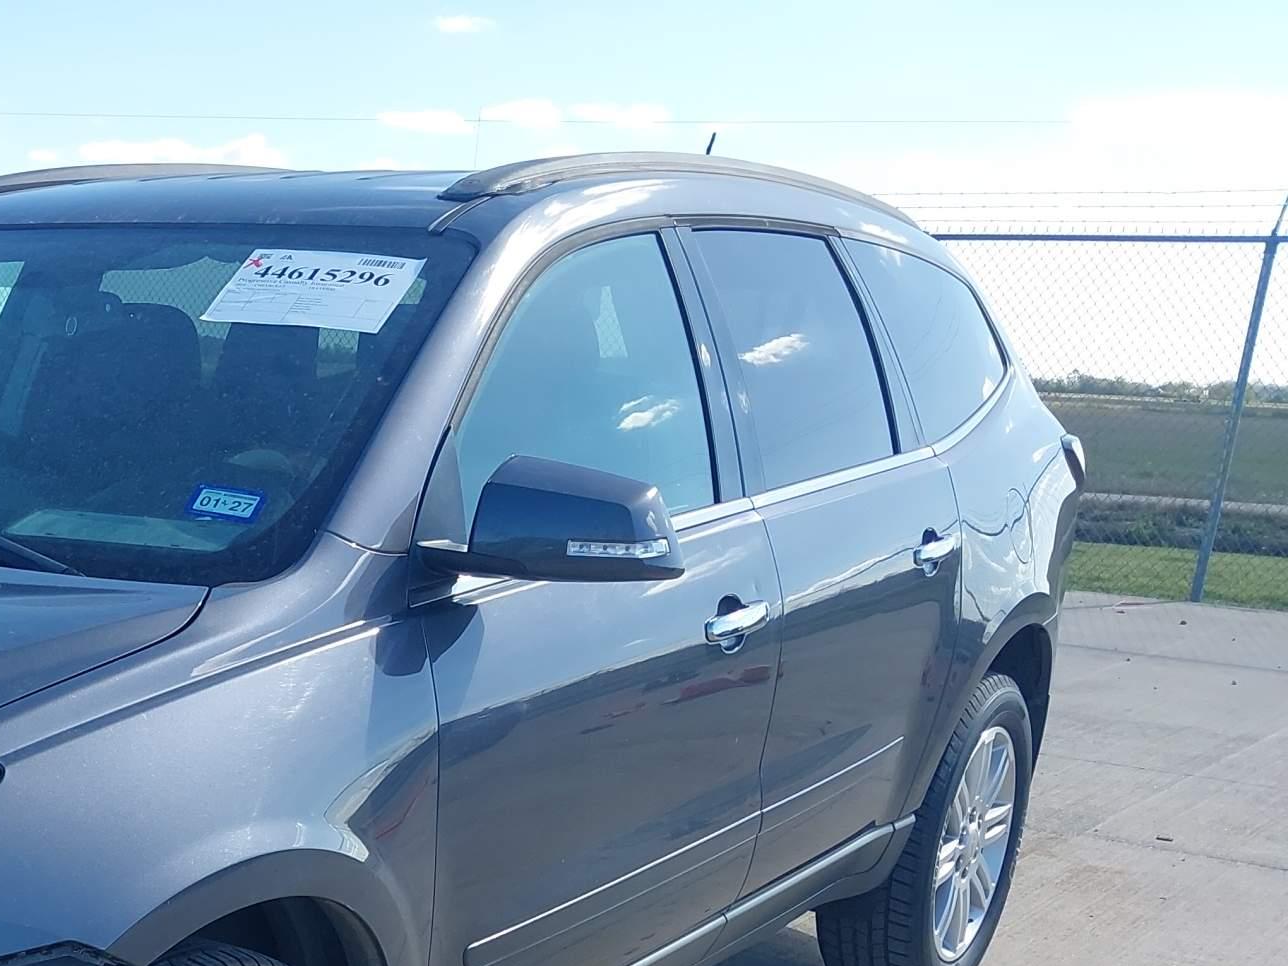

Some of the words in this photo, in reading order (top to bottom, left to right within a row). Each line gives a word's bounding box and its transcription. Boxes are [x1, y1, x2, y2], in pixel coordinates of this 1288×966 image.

[254, 263, 393, 288] 44615296
[199, 495, 222, 509] 01
[228, 500, 254, 513] 27
